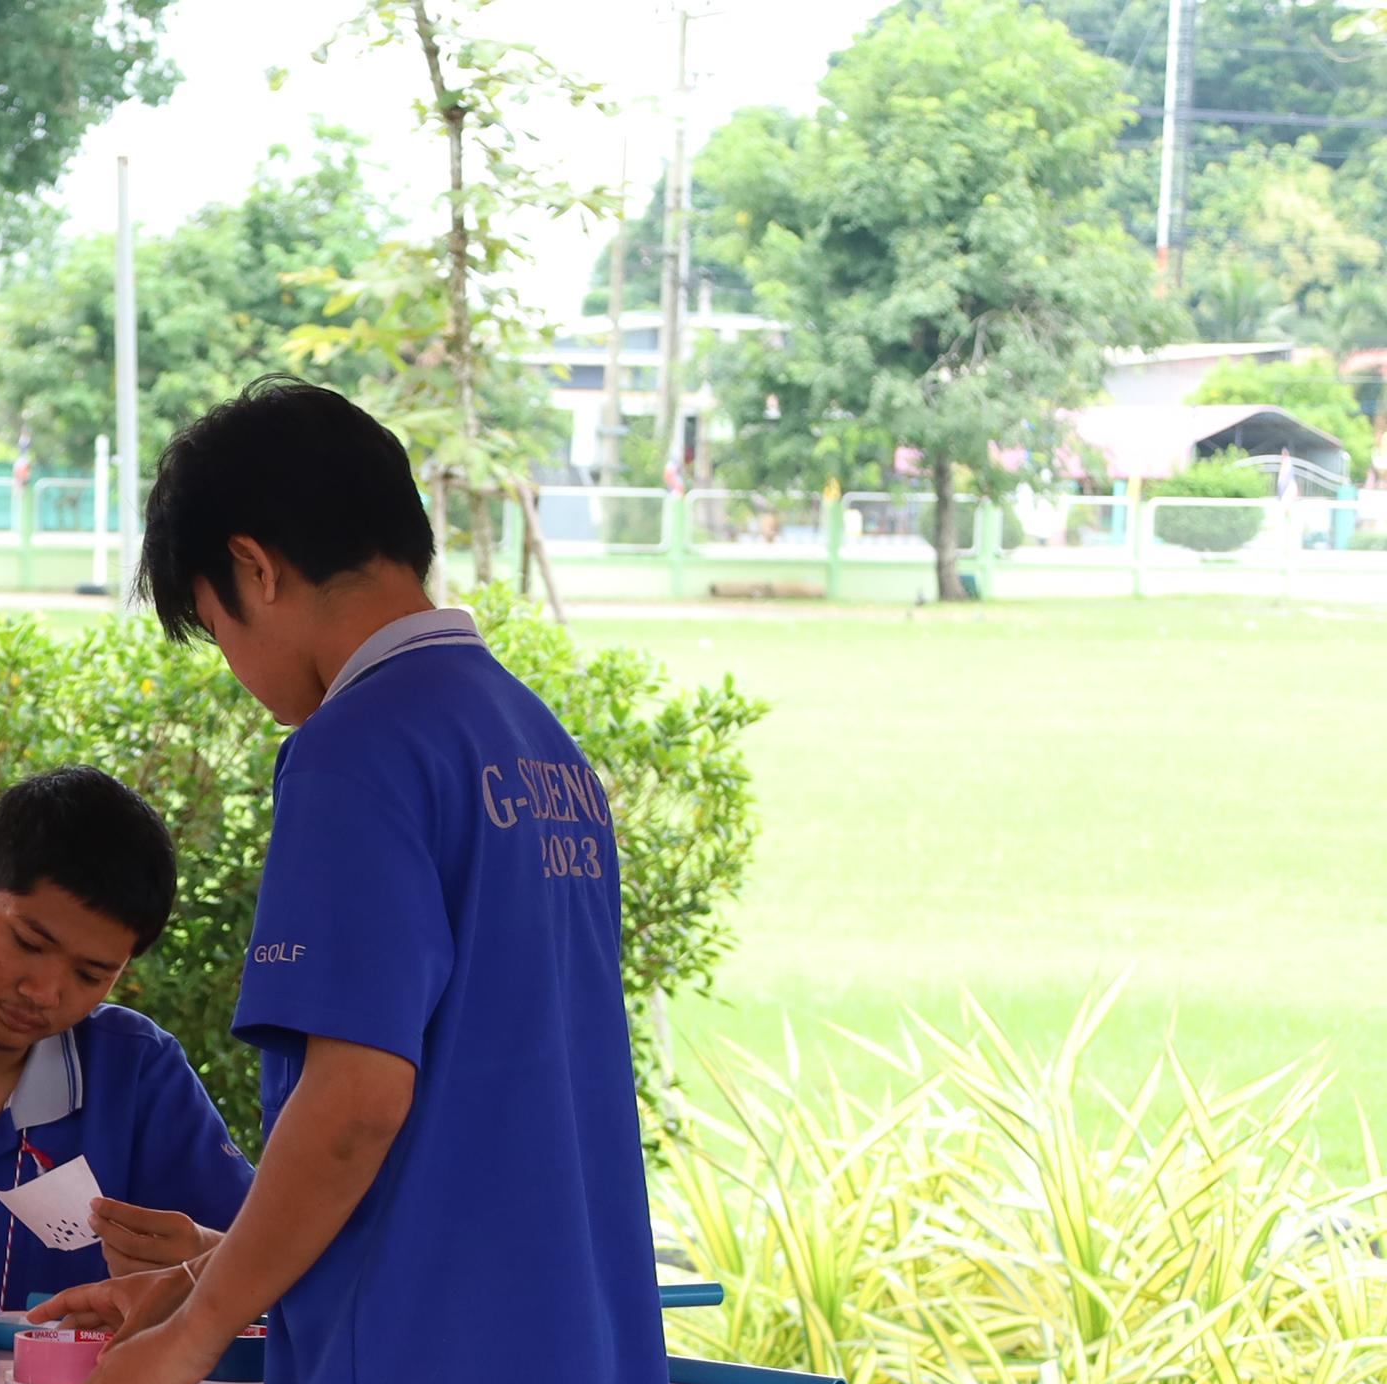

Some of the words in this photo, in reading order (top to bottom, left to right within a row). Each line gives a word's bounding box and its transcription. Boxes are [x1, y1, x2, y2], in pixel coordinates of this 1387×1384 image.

[481, 757, 609, 830] G-SCIENC
[254, 942, 307, 963] GOLF
[34, 1329, 59, 1339] SPARCO
[80, 1331, 105, 1341] SPARCO
